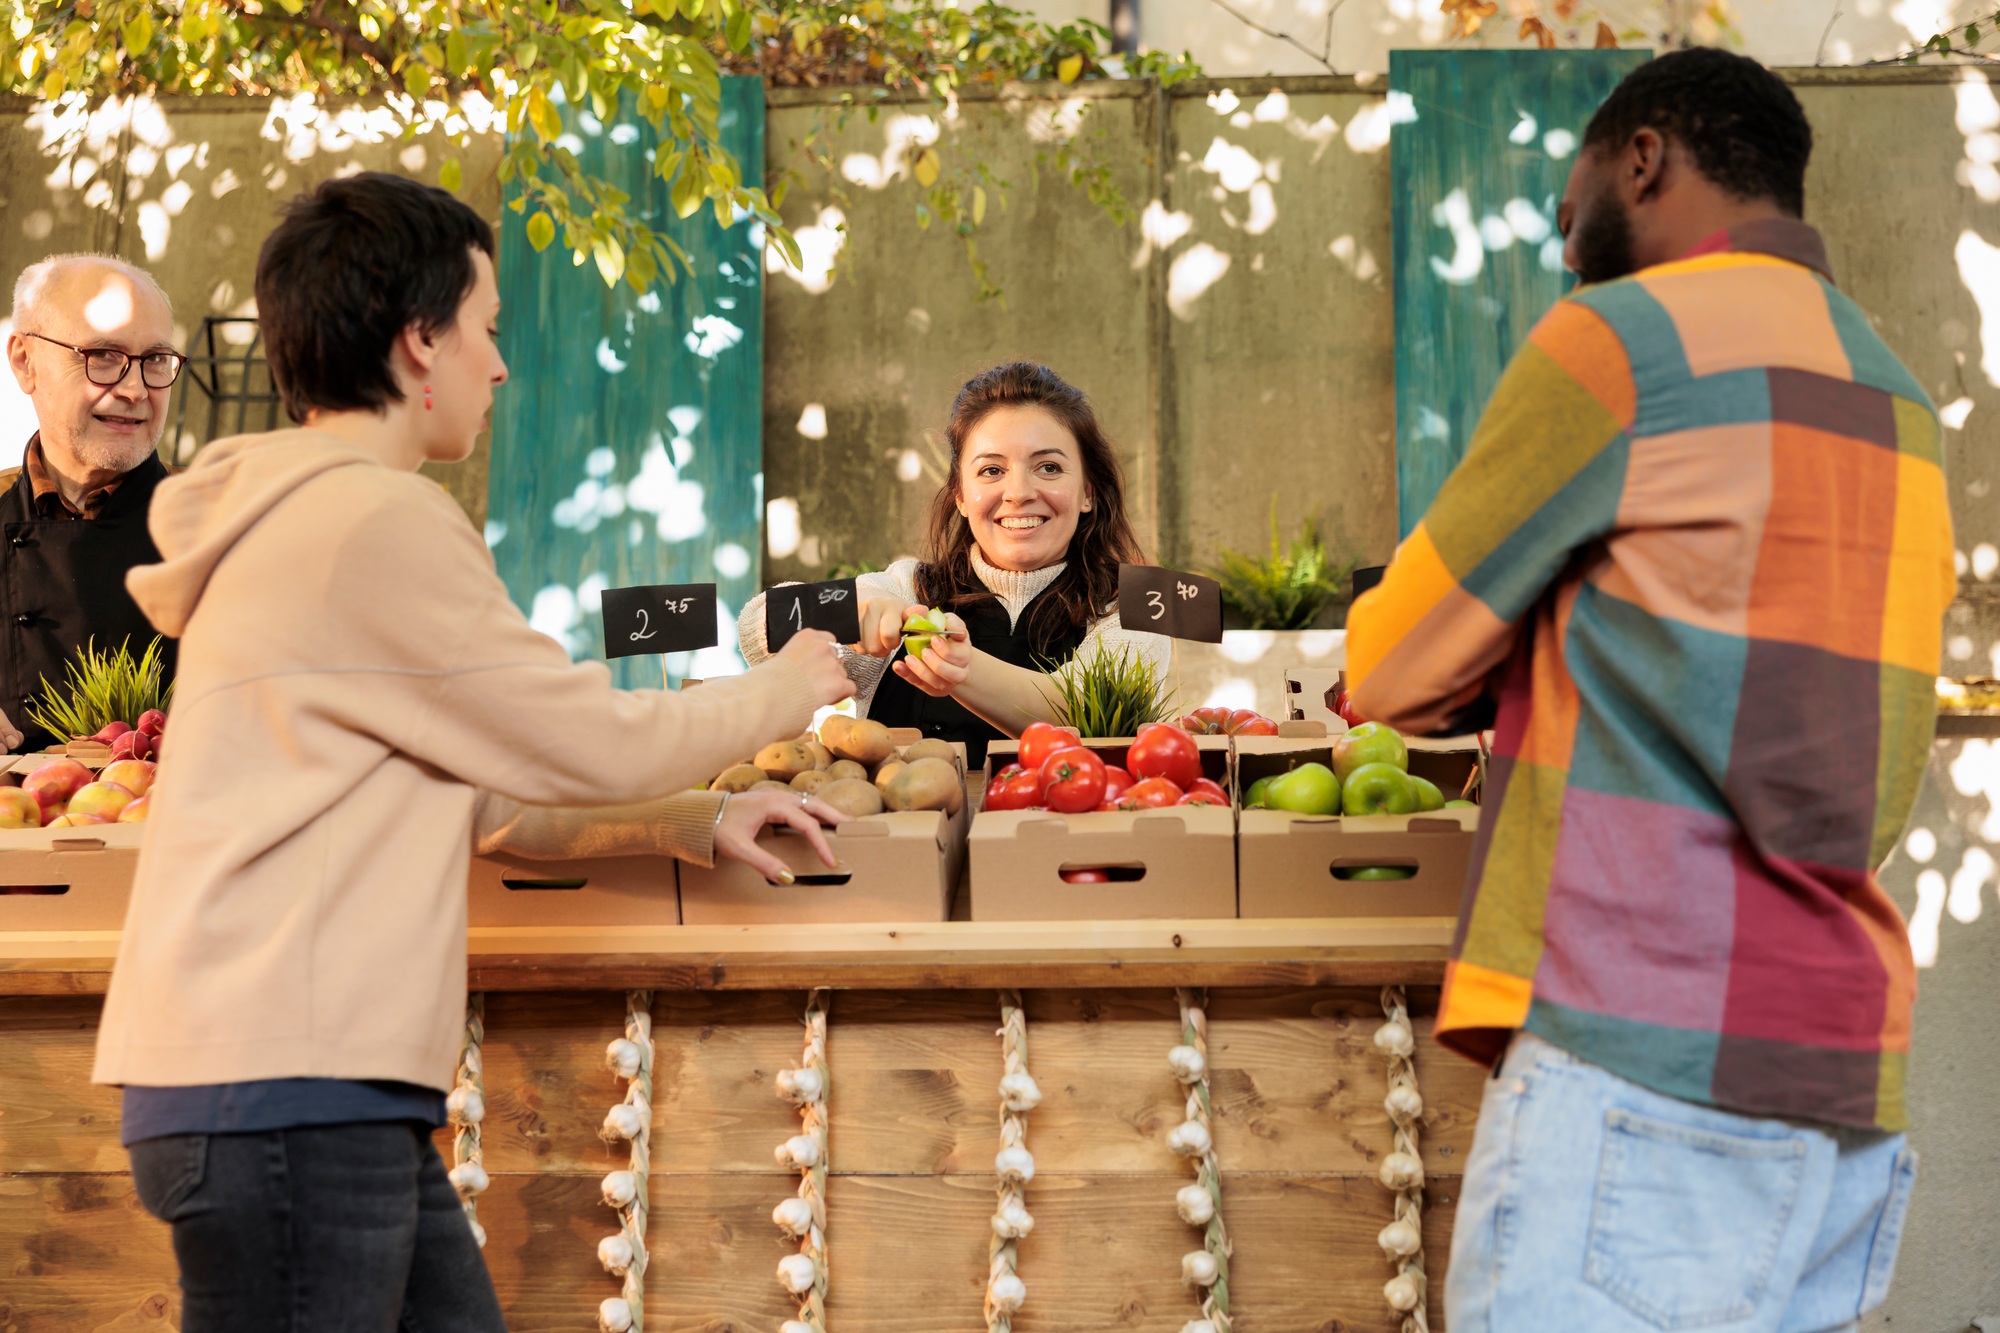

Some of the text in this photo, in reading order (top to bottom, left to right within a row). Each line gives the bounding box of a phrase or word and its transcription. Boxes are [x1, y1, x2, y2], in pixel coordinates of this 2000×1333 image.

[629, 597, 698, 641] 2 75
[789, 588, 848, 631] 1 50
[1146, 580, 1198, 620] 3 70
